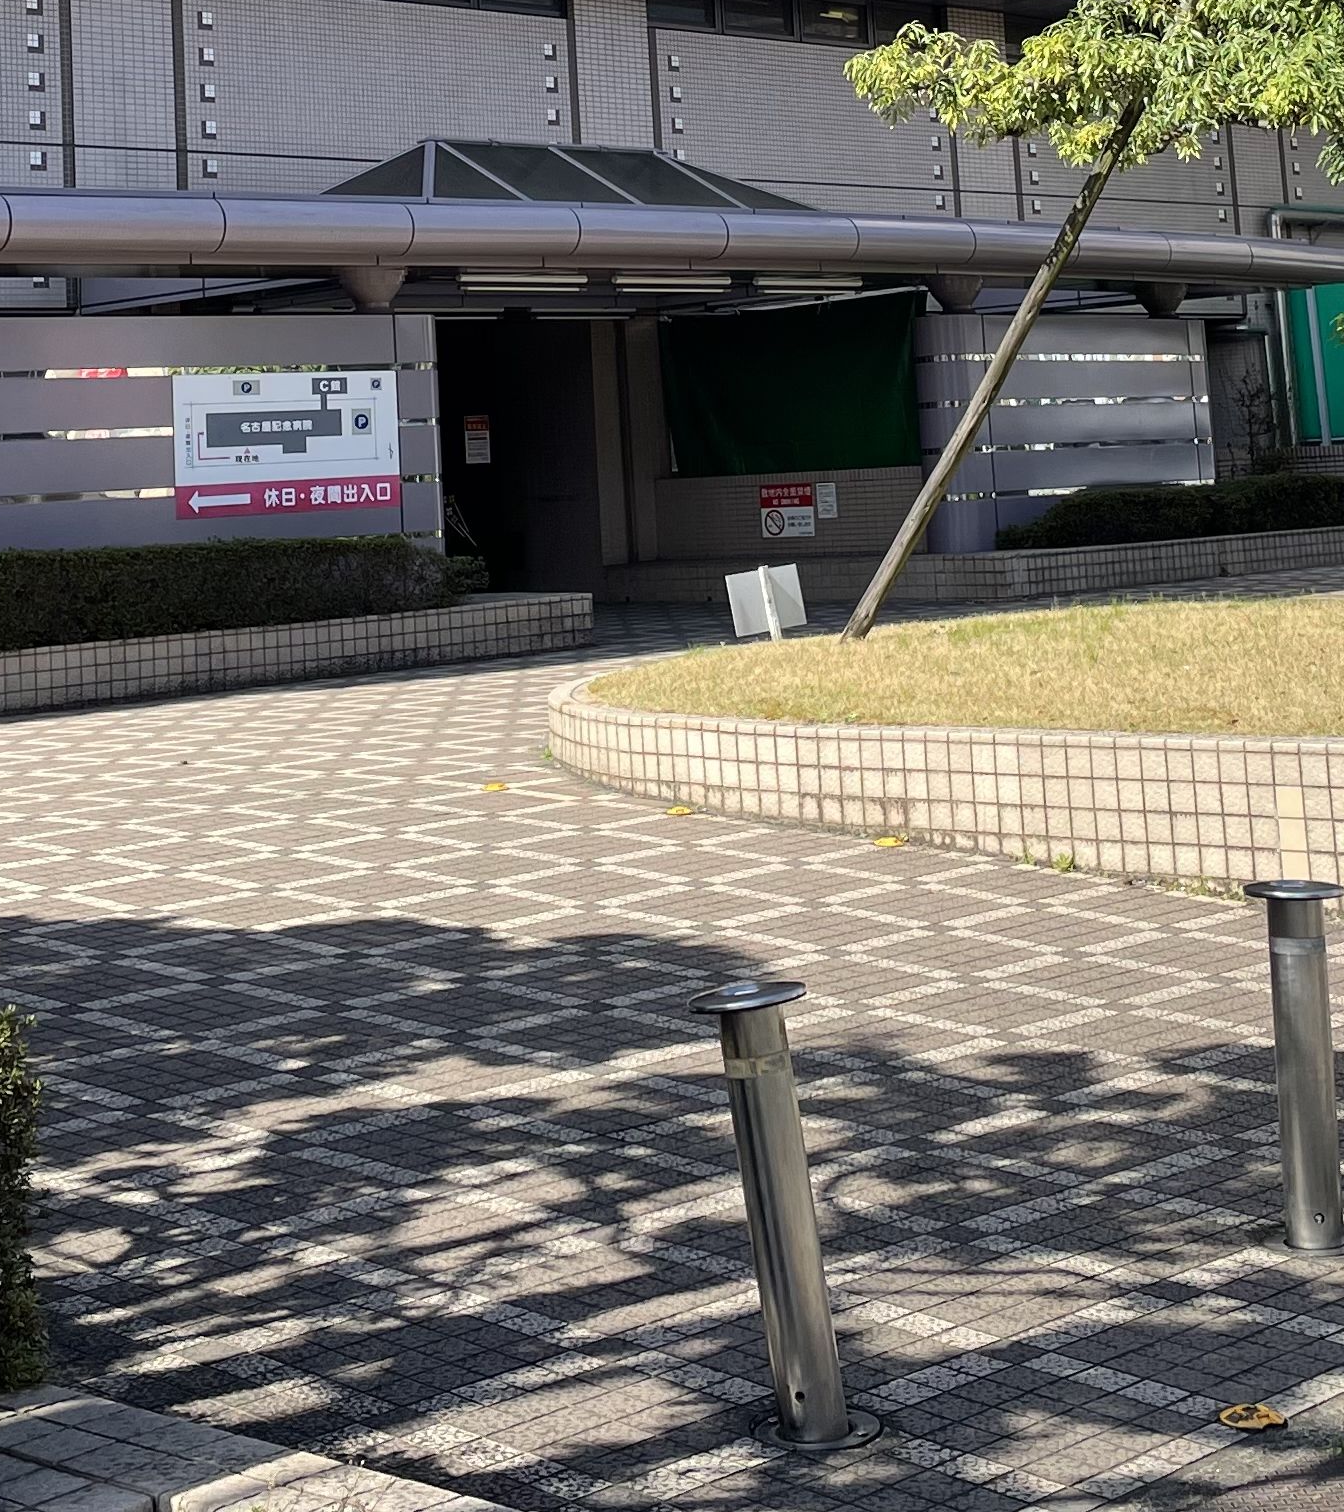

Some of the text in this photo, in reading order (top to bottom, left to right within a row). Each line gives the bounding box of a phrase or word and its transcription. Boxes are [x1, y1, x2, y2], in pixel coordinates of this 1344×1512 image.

[240, 420, 313, 433] 名古屋記念病院
[235, 454, 260, 463] 現在地
[264, 482, 391, 508] 休日・夜間出入口
